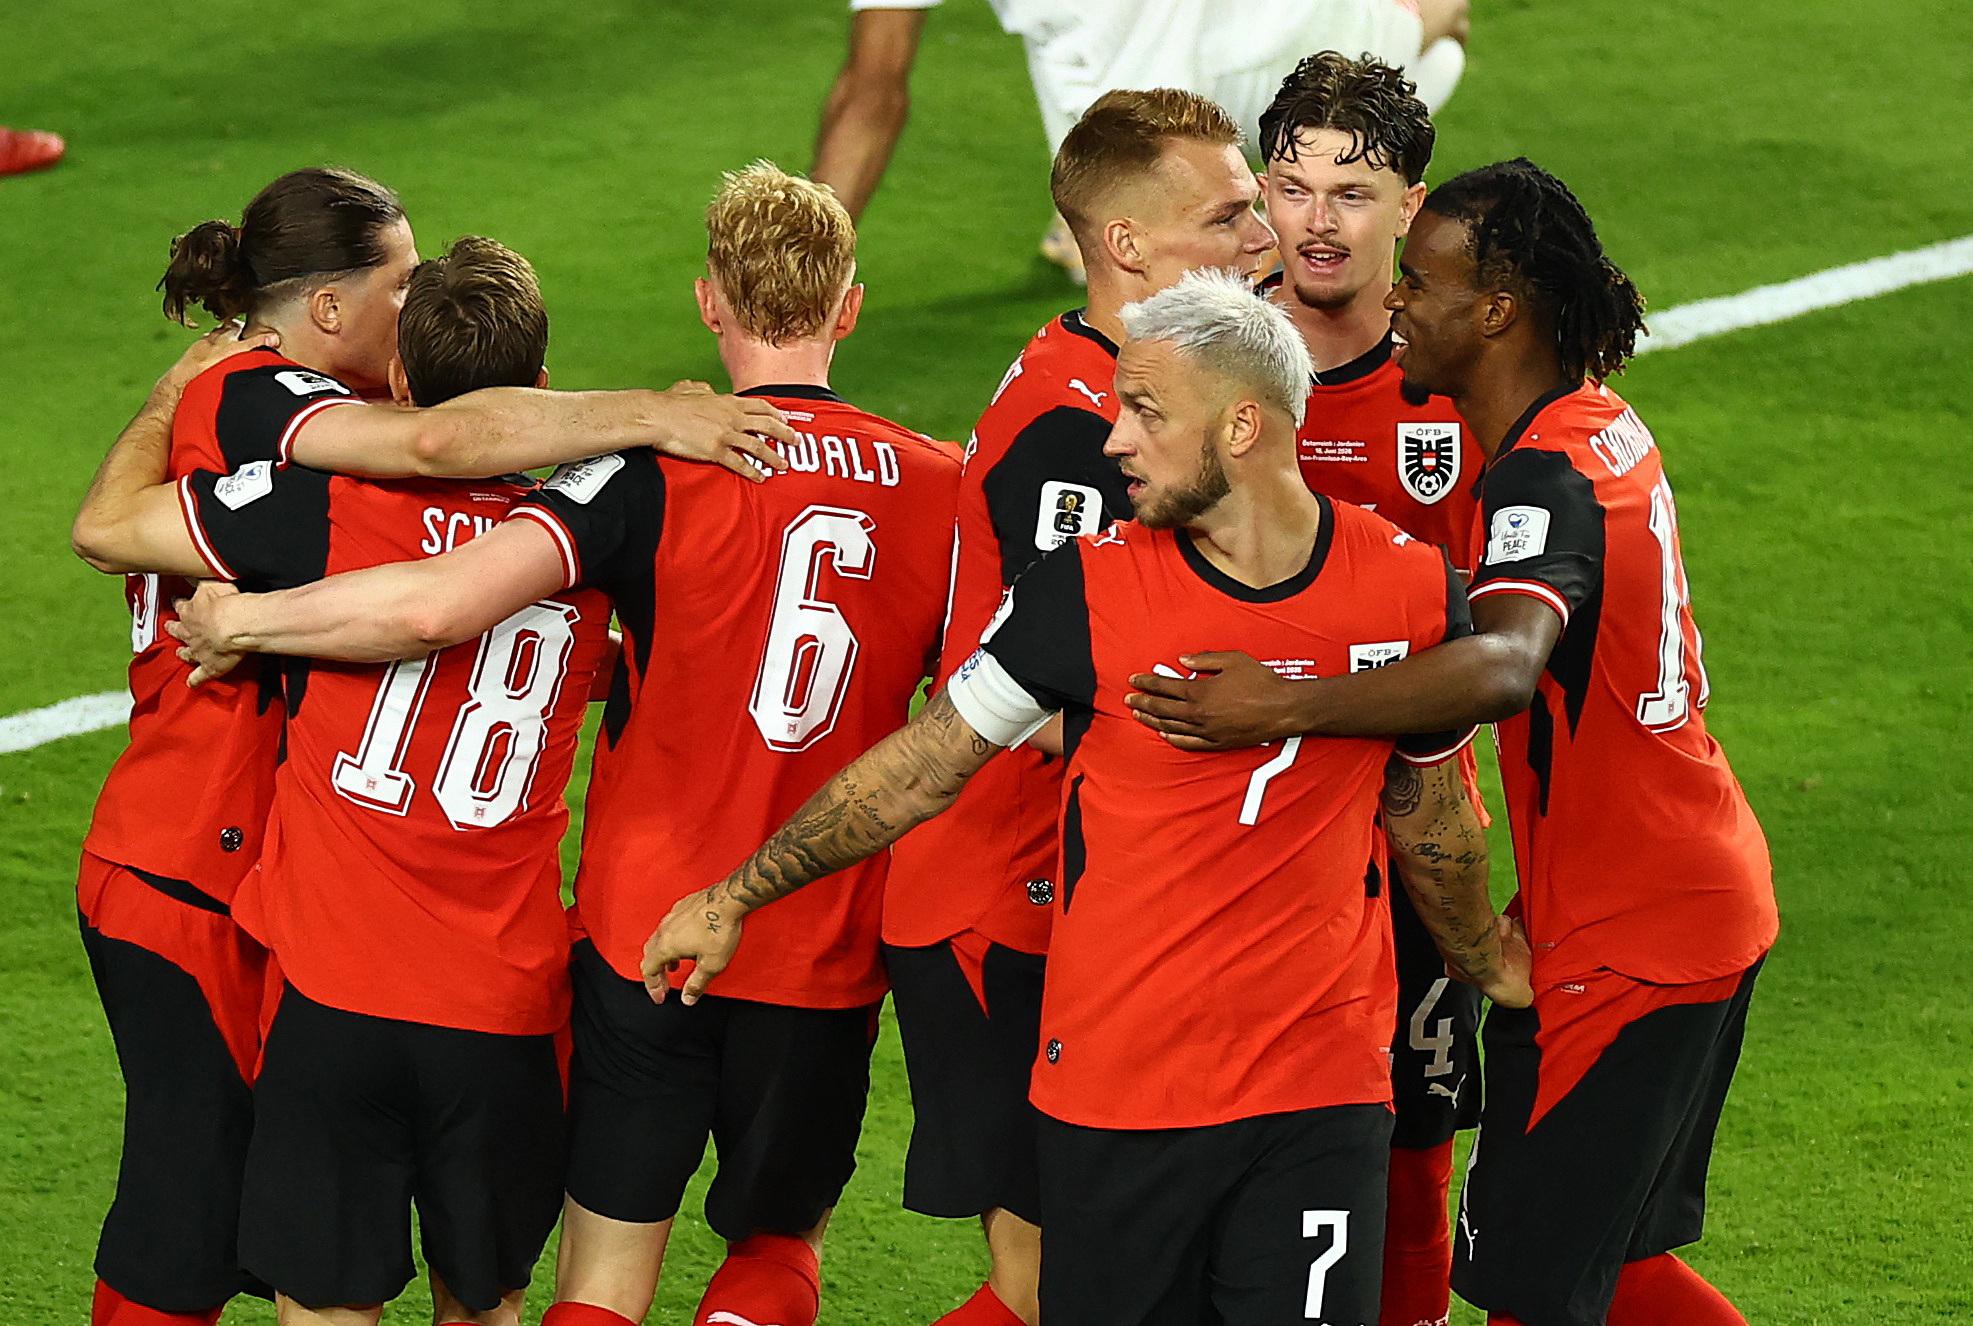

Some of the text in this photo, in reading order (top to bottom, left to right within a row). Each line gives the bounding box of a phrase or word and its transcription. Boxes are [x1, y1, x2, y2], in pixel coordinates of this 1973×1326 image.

[743, 431, 900, 487] WALD
[1416, 427, 1442, 436] ÖFB
[1502, 539, 1528, 552] PEACE
[748, 504, 878, 753] 6
[1367, 648, 1392, 657] ÖFB
[331, 599, 582, 831] 18
[1409, 977, 1455, 1078] 4
[1302, 1209, 1351, 1319] 7
